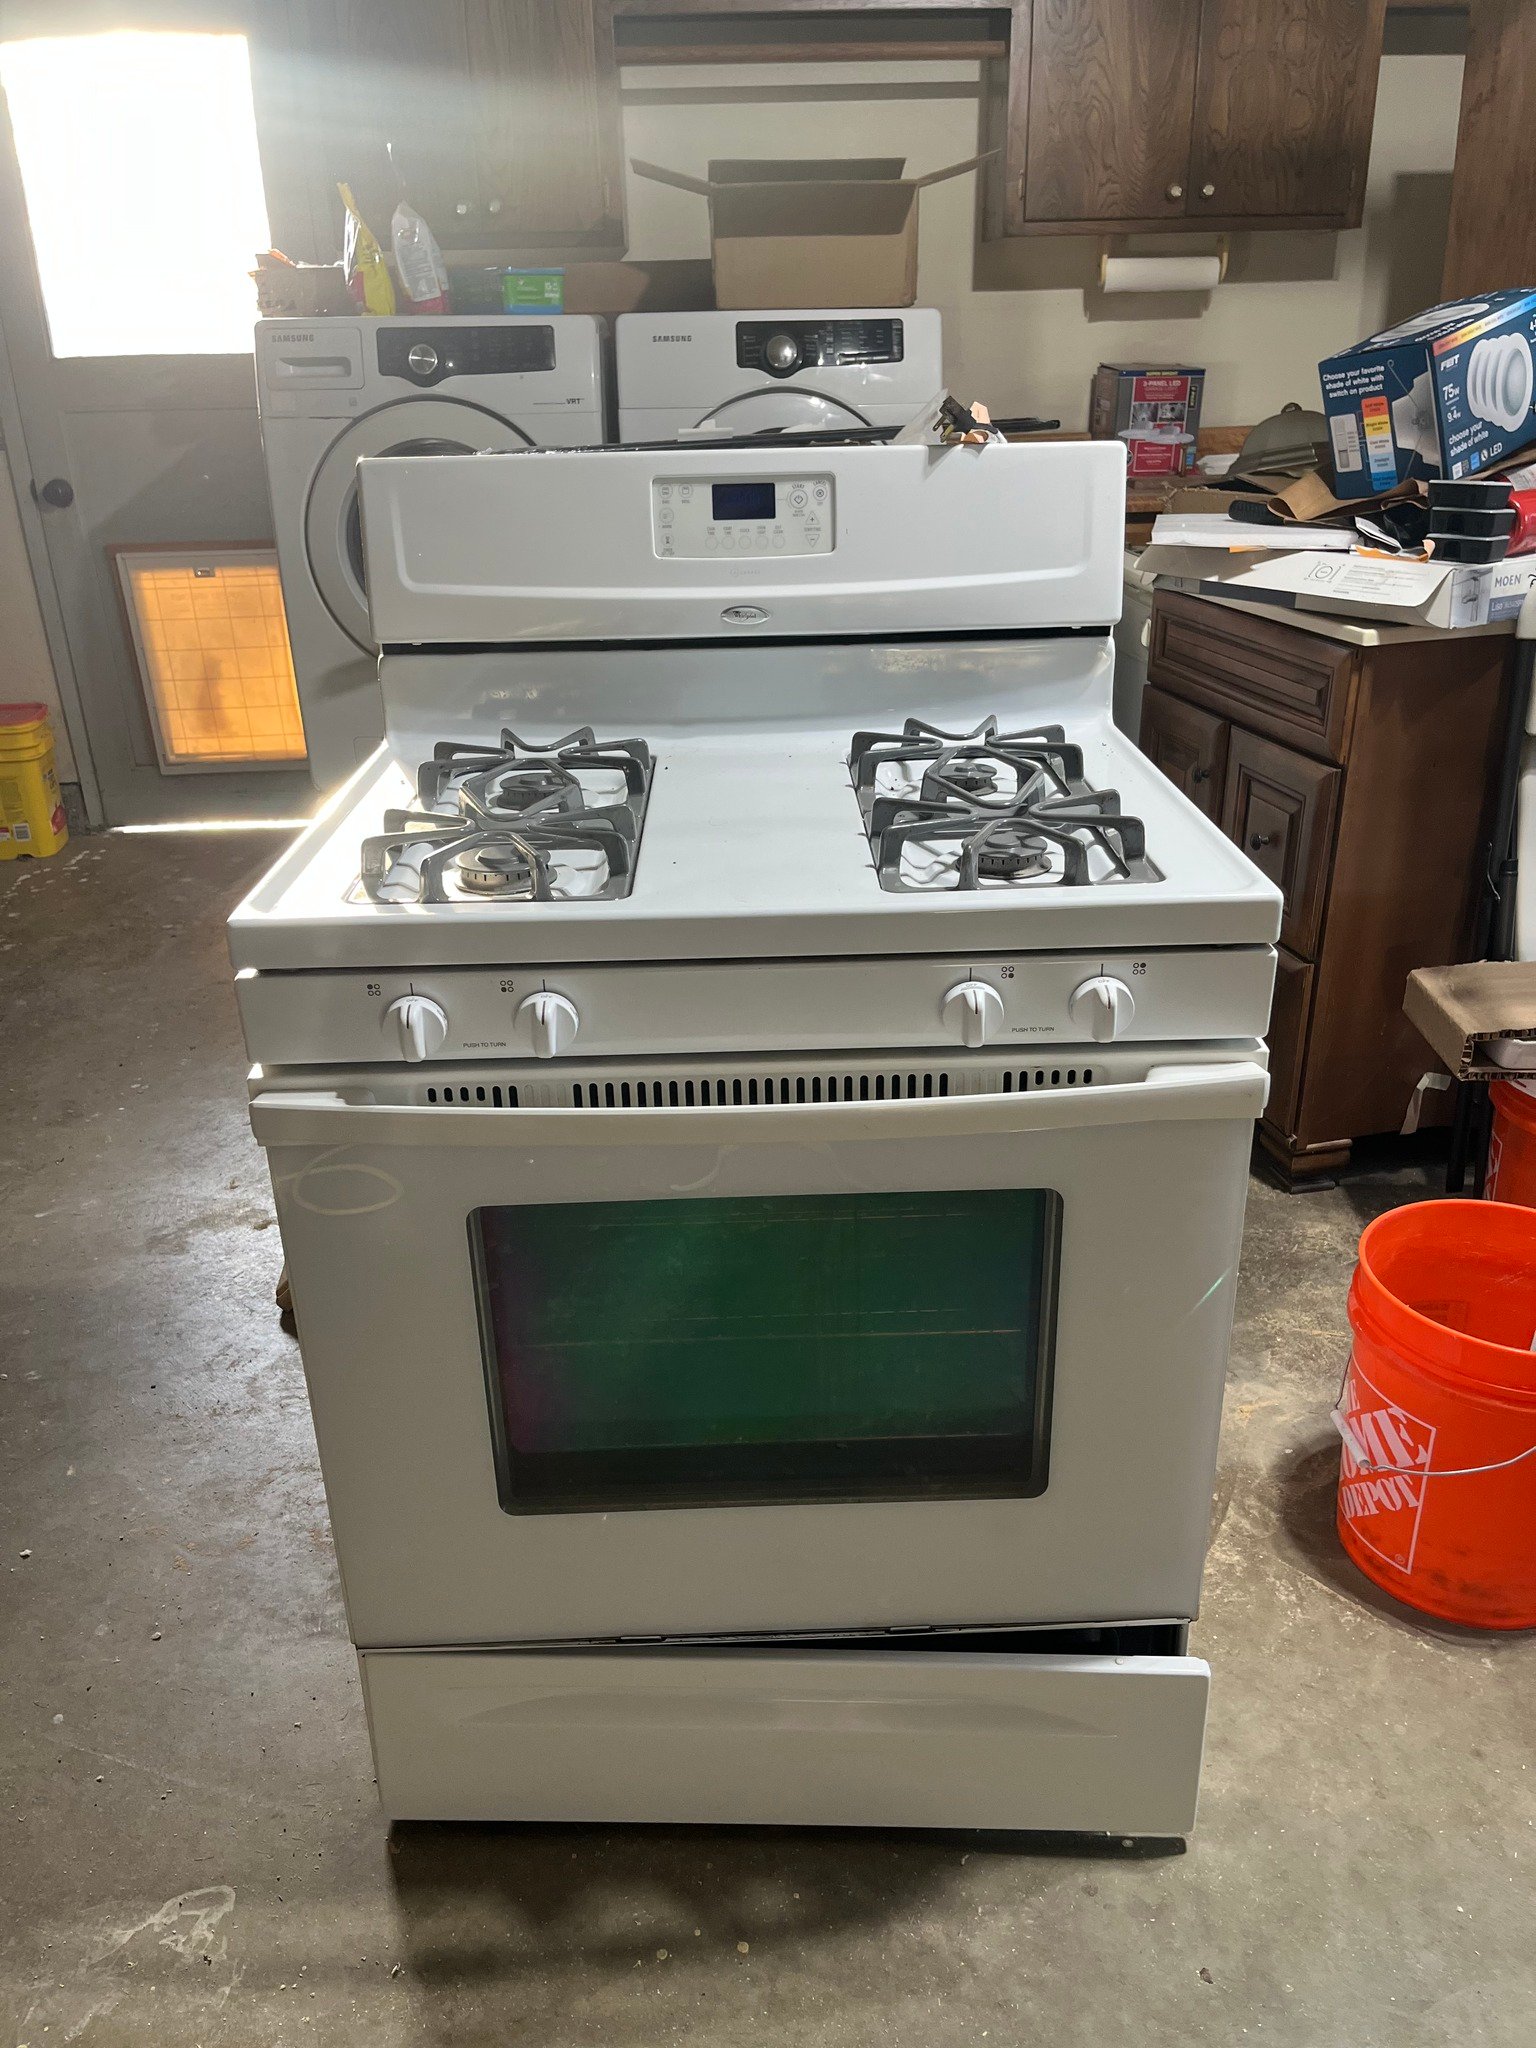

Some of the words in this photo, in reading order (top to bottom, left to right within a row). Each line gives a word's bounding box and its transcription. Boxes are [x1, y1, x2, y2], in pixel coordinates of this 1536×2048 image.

[271, 334, 314, 343] SAMSUNG
[1323, 373, 1345, 381] Choose
[1346, 370, 1360, 379] your
[1361, 366, 1385, 374] favorite
[1326, 381, 1344, 390] shade
[1345, 379, 1351, 387] of
[1352, 377, 1369, 385] white
[1370, 373, 1385, 382] with
[1329, 389, 1349, 398] switch
[1358, 383, 1383, 395] product
[1448, 428, 1469, 444] choose
[1470, 421, 1482, 435] your
[1450, 441, 1468, 457] shade
[1474, 430, 1489, 443] white
[1489, 442, 1503, 457] LED
[1495, 574, 1522, 587] MOEN
[1341, 1474, 1419, 1518] DEPOT
